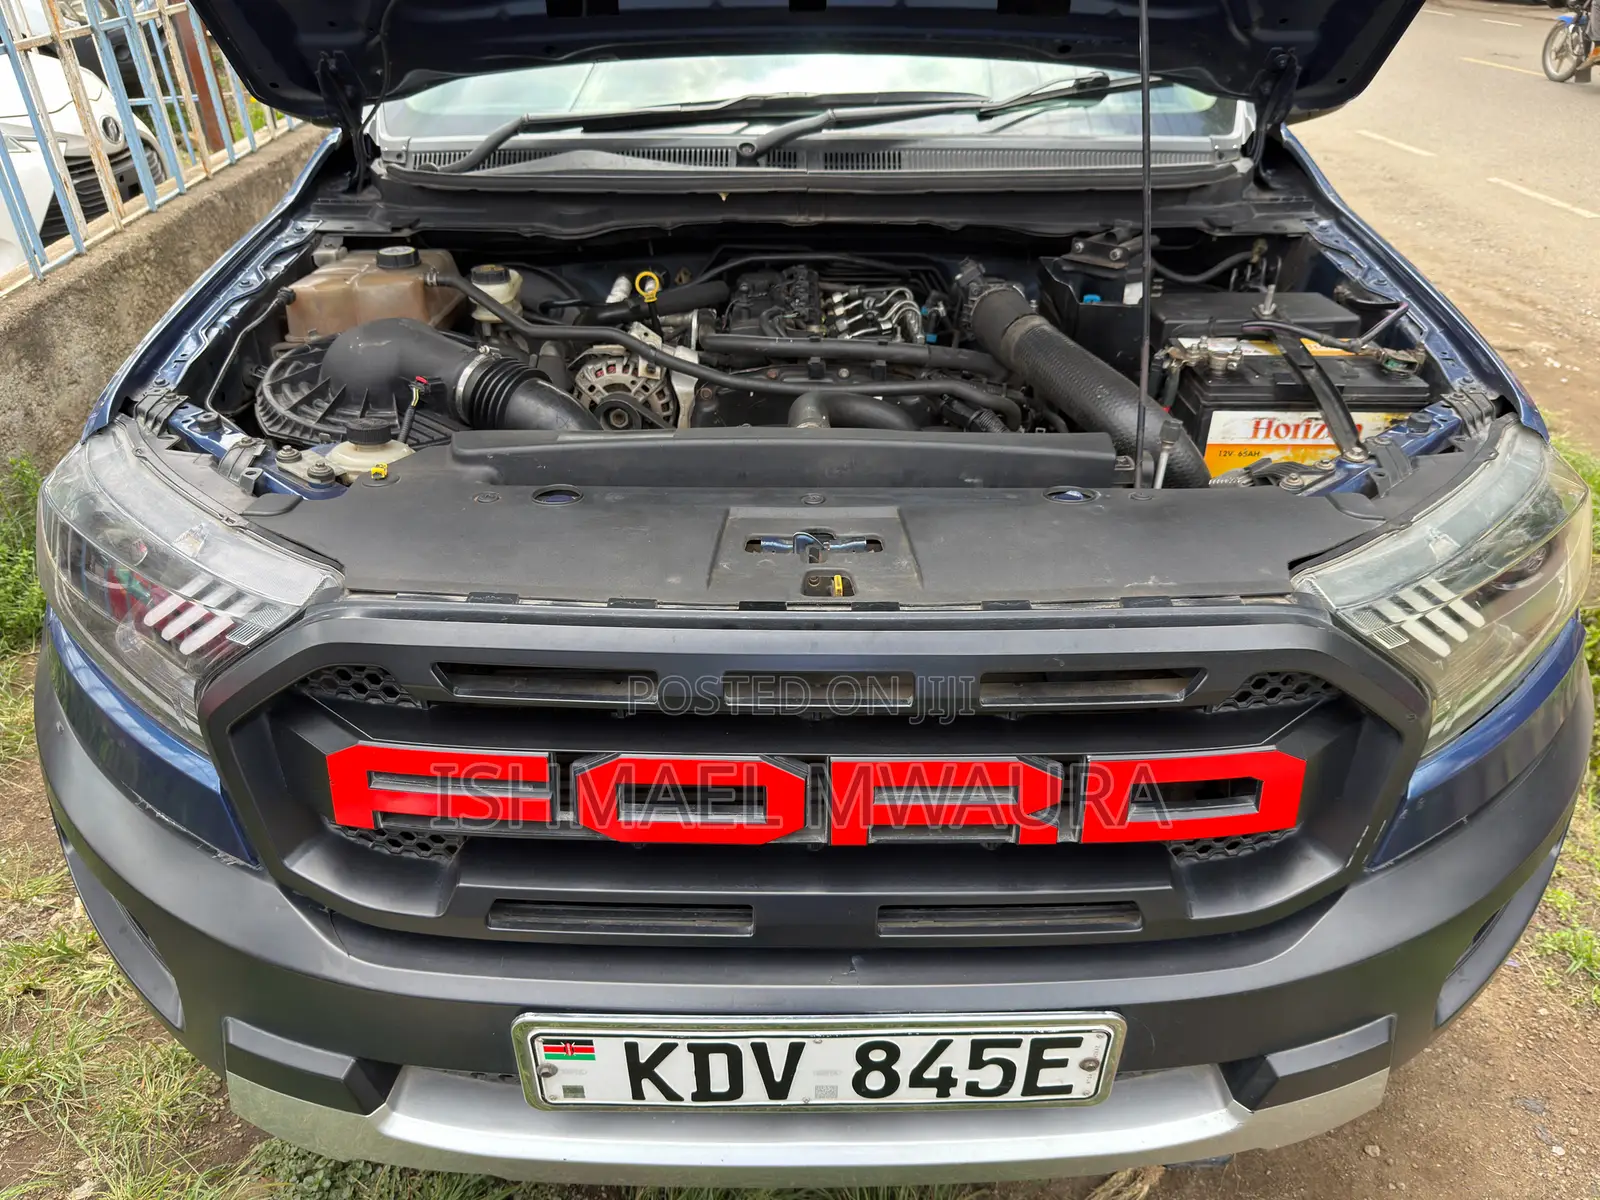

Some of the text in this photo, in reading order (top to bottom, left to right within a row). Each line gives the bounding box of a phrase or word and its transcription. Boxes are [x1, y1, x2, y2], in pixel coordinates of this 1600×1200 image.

[1250, 417, 1363, 441] Horiz
[326, 743, 1307, 846] FORD
[624, 1036, 1085, 1102] KDV 845E
